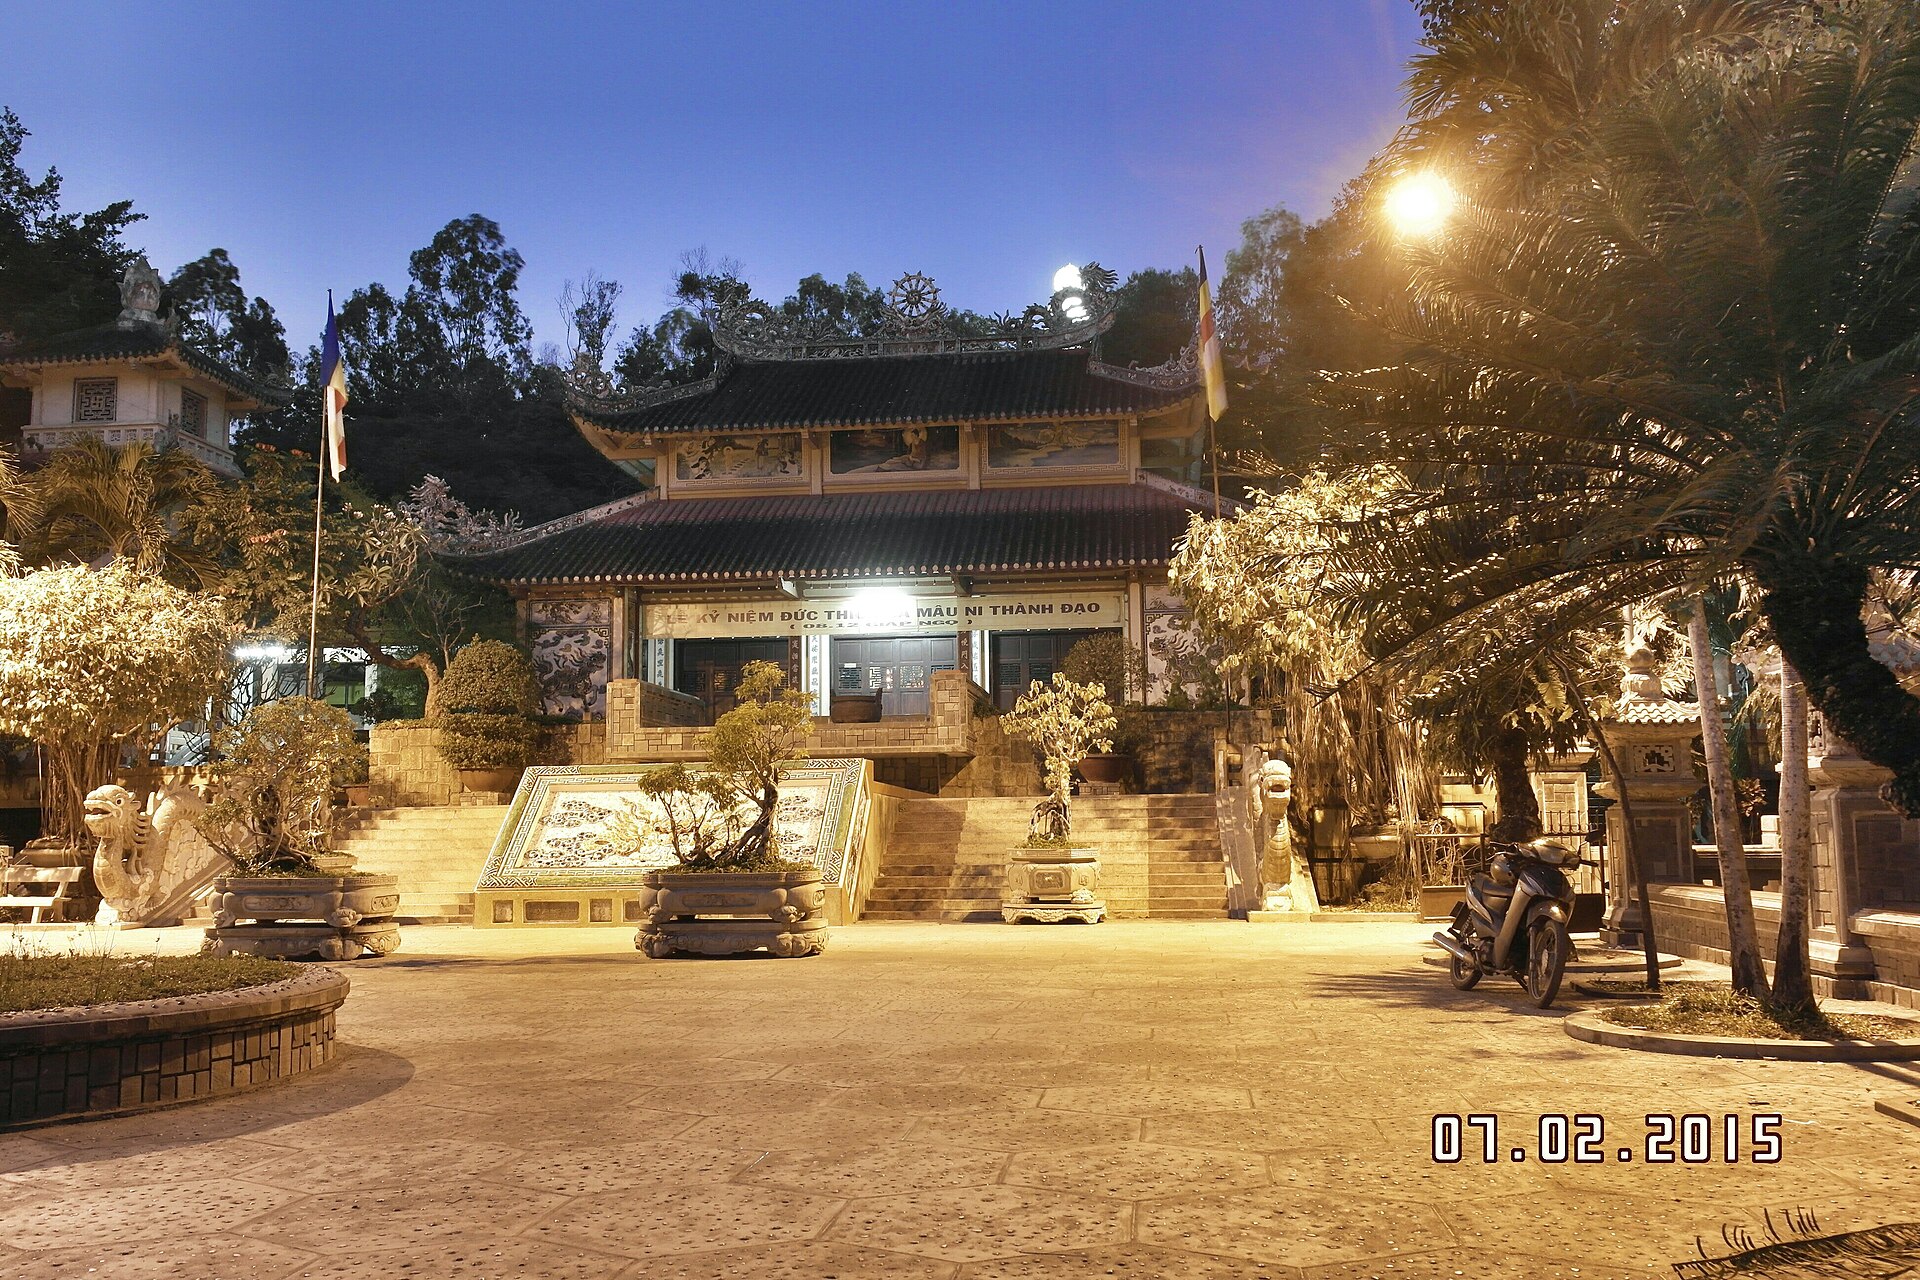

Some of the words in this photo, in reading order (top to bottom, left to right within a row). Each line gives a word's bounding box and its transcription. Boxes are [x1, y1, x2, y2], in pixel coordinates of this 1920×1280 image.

[727, 609, 774, 624] NIỆM
[780, 608, 818, 621] ĐỨC
[916, 604, 958, 618] MÂU
[964, 605, 983, 617] NI
[989, 602, 1054, 616] THÀNH
[1060, 602, 1100, 615] ĐẠO
